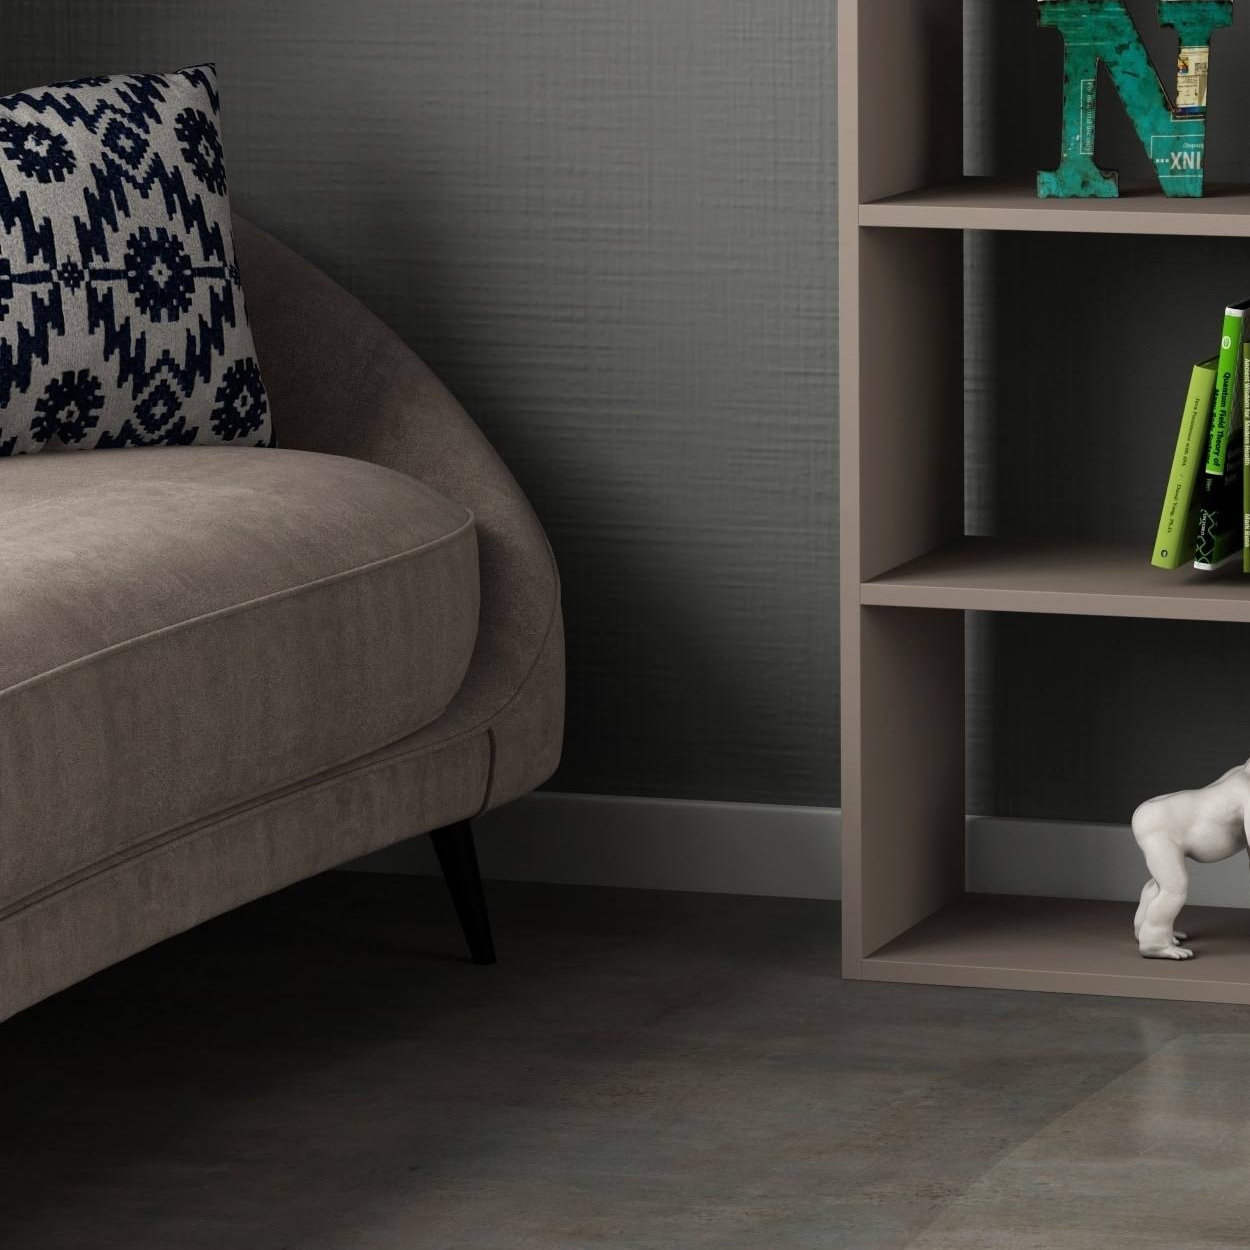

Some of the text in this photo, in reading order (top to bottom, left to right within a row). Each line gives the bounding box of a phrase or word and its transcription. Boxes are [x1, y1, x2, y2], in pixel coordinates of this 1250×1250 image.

[1213, 372, 1232, 468] Quantum Field Theory of
